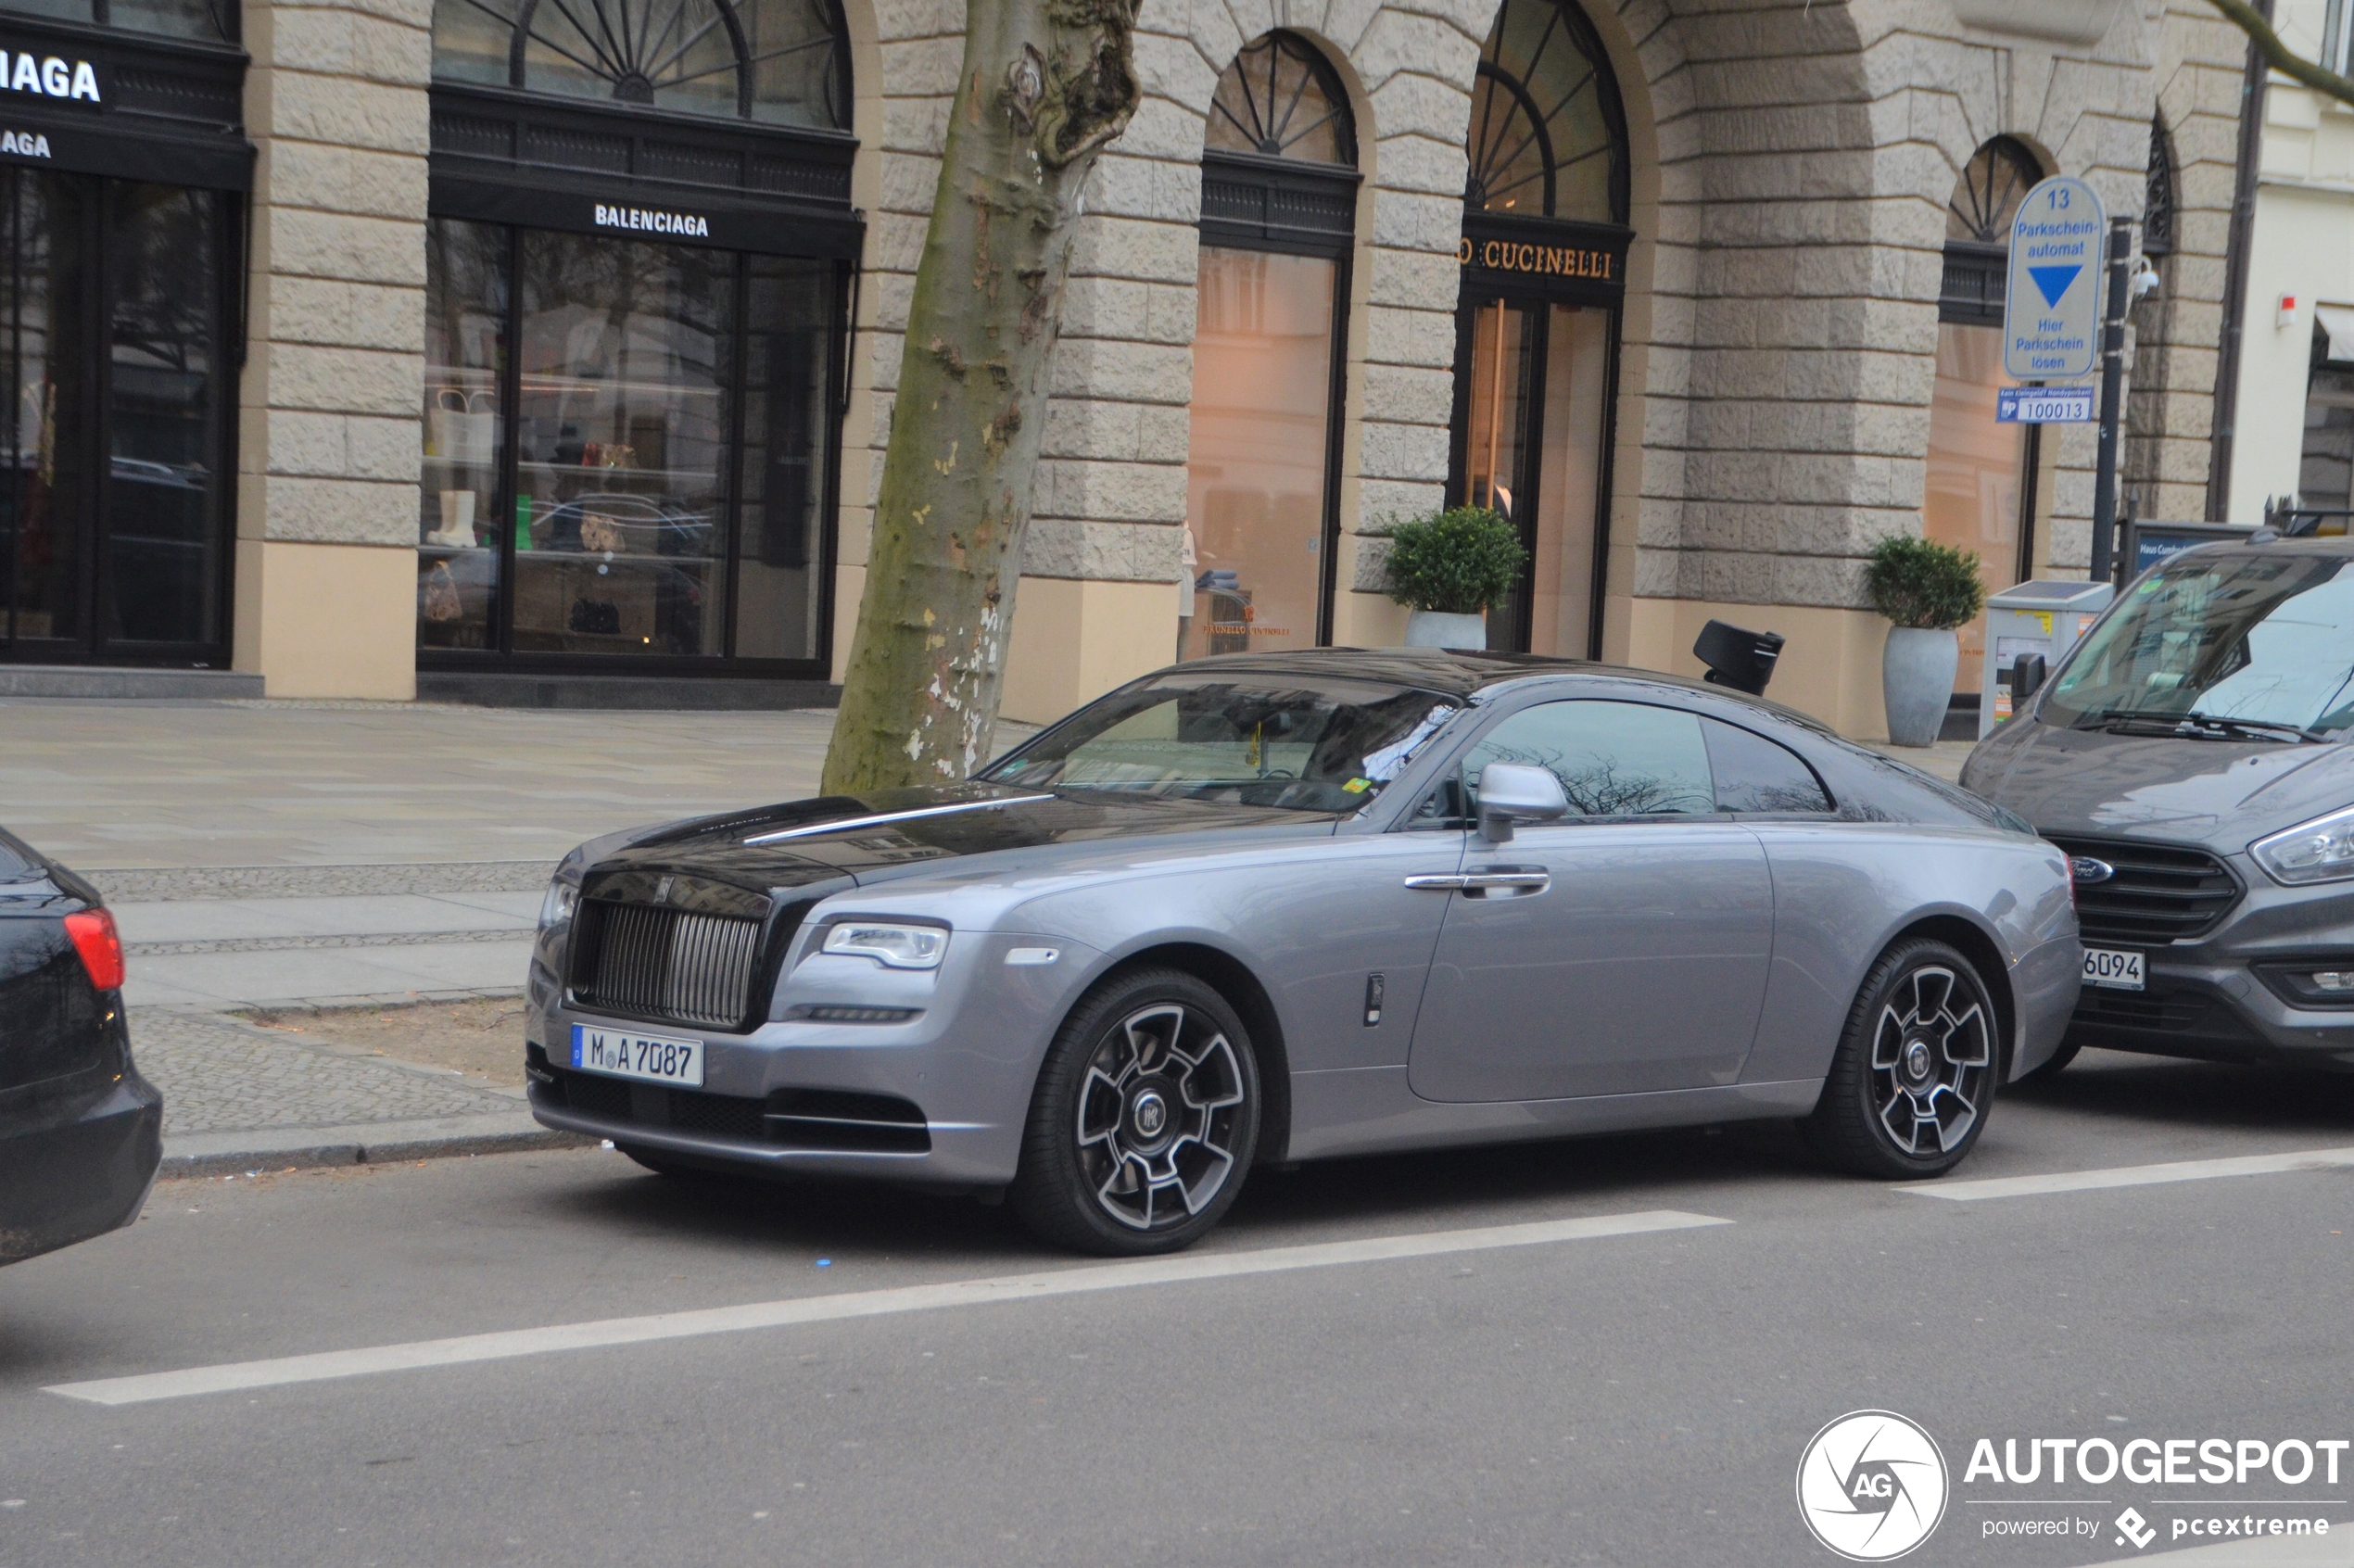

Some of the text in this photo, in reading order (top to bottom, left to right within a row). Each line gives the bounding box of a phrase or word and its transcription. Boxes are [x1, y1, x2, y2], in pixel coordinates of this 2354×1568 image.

[2047, 188, 2070, 209] 13
[595, 203, 709, 236] BALENCIAGA
[2018, 219, 2099, 237] Parkschein-
[2028, 241, 2084, 258] automat
[1485, 240, 1612, 278] CUCINELLI
[2038, 318, 2064, 332] Hier
[2016, 335, 2083, 351] Parkschein
[2031, 354, 2065, 369] lösen
[2027, 403, 2082, 418] 100013
[2140, 543, 2158, 554] Haus
[1204, 625, 1247, 635] BRUNELLO
[2084, 951, 2139, 980] 6094
